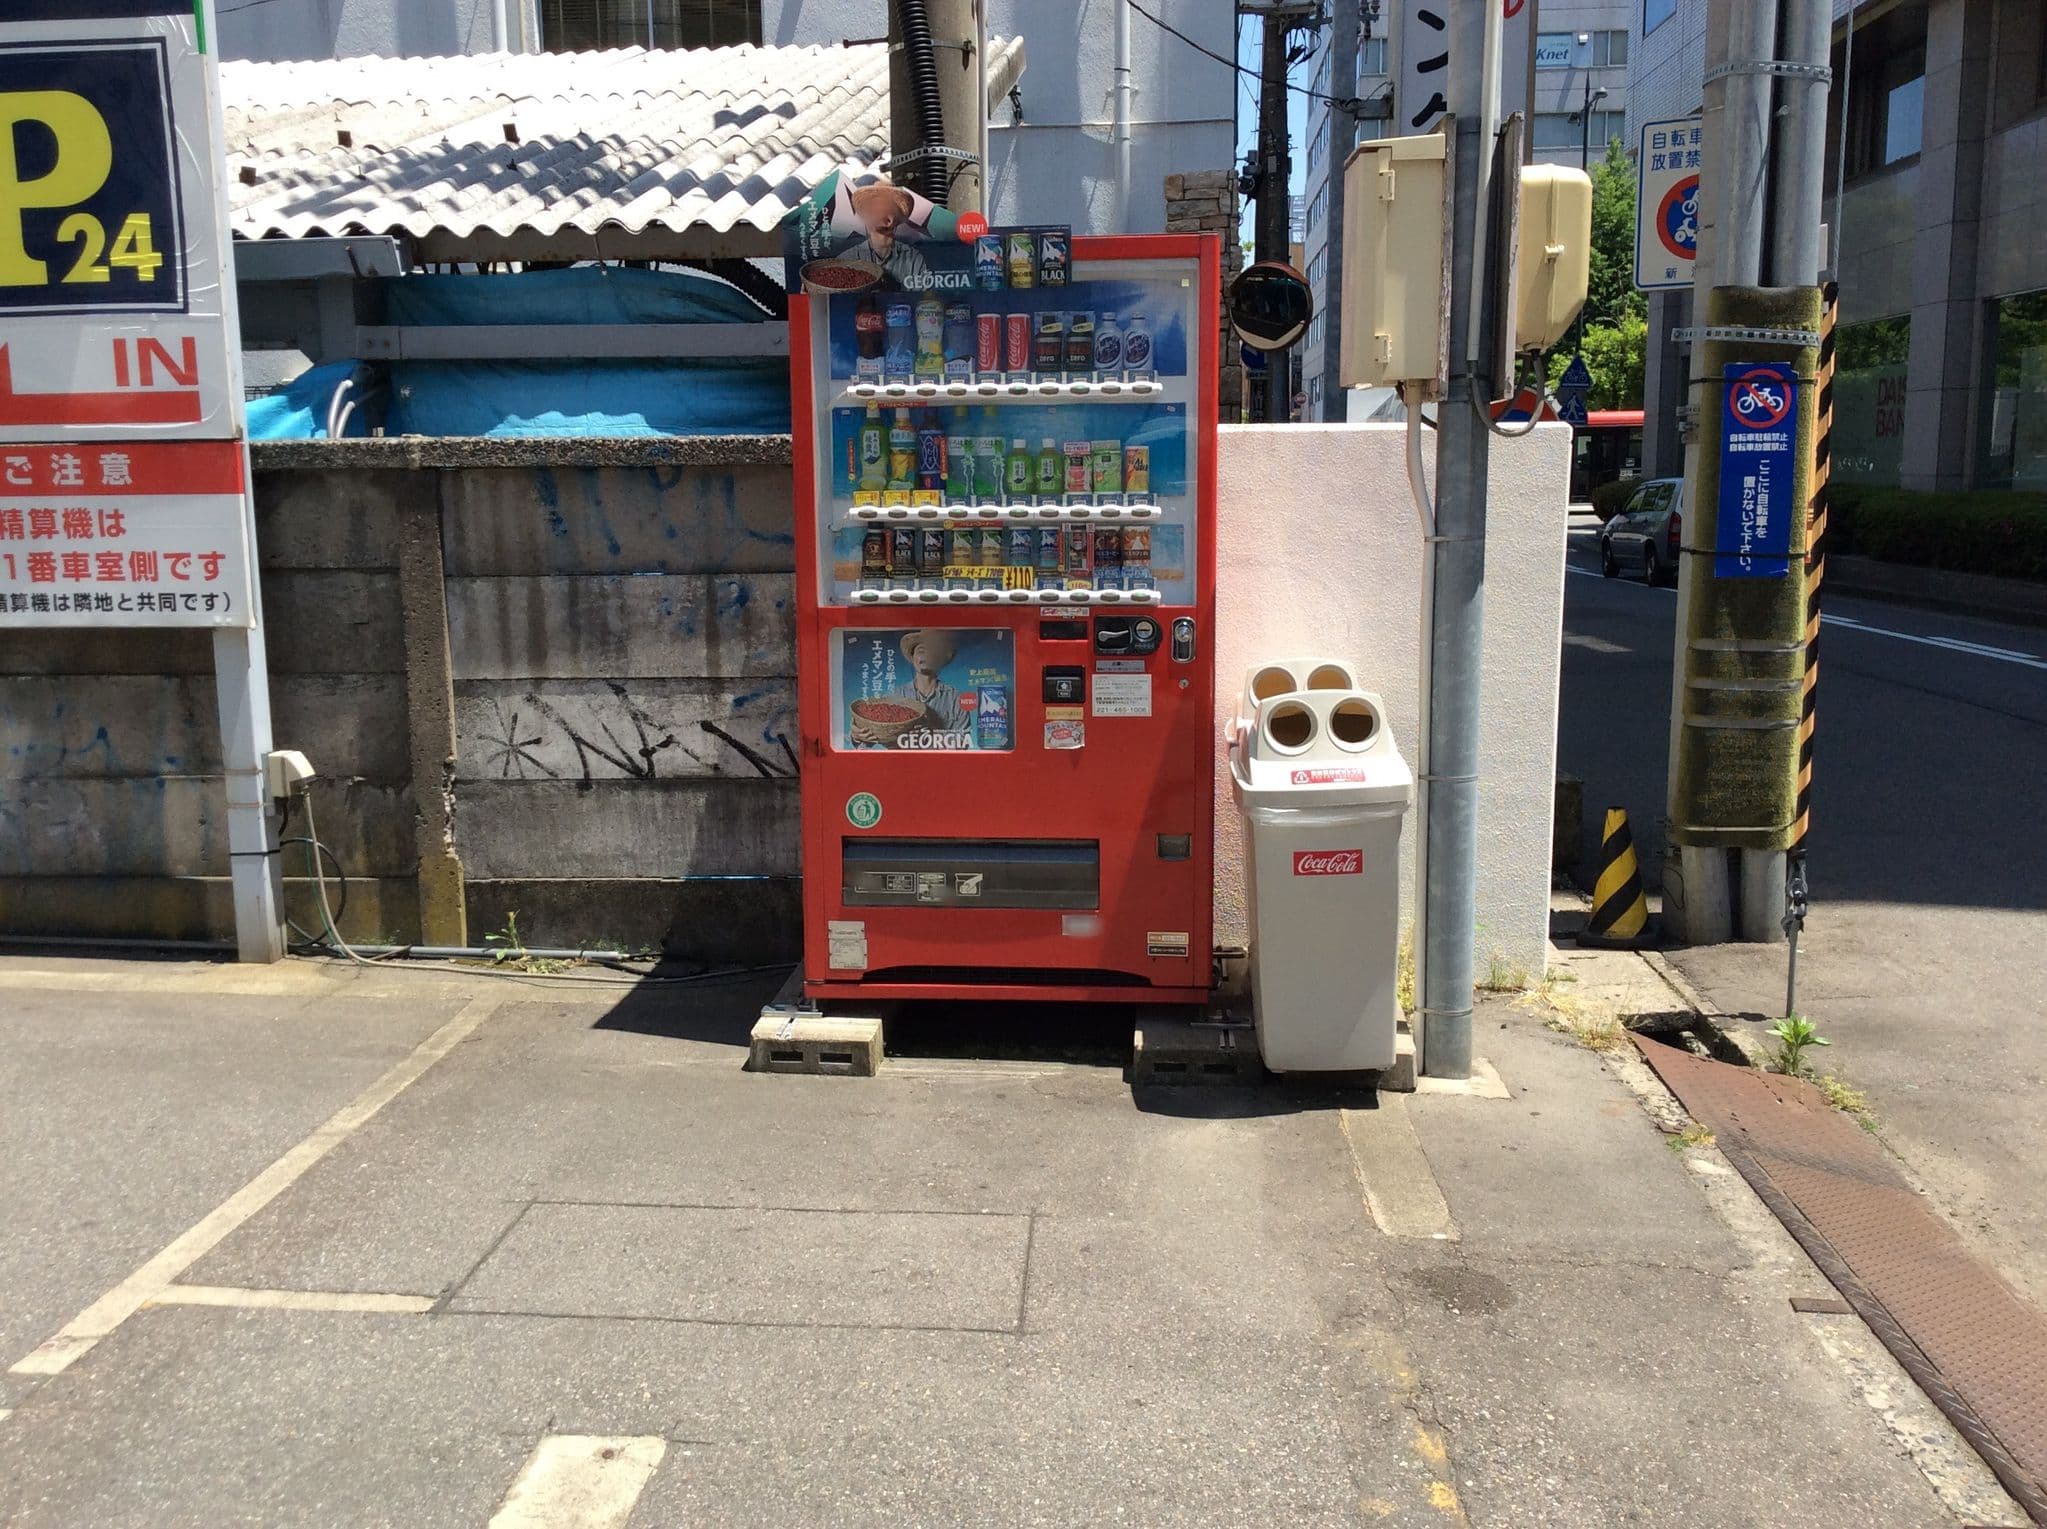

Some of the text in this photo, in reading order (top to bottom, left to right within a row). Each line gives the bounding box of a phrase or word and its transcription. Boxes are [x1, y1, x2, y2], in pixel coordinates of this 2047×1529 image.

[0, 90, 163, 287] P 24
[959, 223, 985, 234] NEW!
[903, 269, 972, 290] GEORGIA
[1040, 269, 1066, 281] BLACK
[112, 336, 199, 387] IN
[6, 452, 134, 486] ご注意
[1755, 459, 1770, 539] ここに自転車を
[0, 507, 127, 540] 精算機は
[4, 551, 227, 583] 1番車室側です
[1005, 567, 1032, 589] ¥110
[897, 728, 973, 750] GEORGIA
[1298, 852, 1358, 874] Coca-Cola
